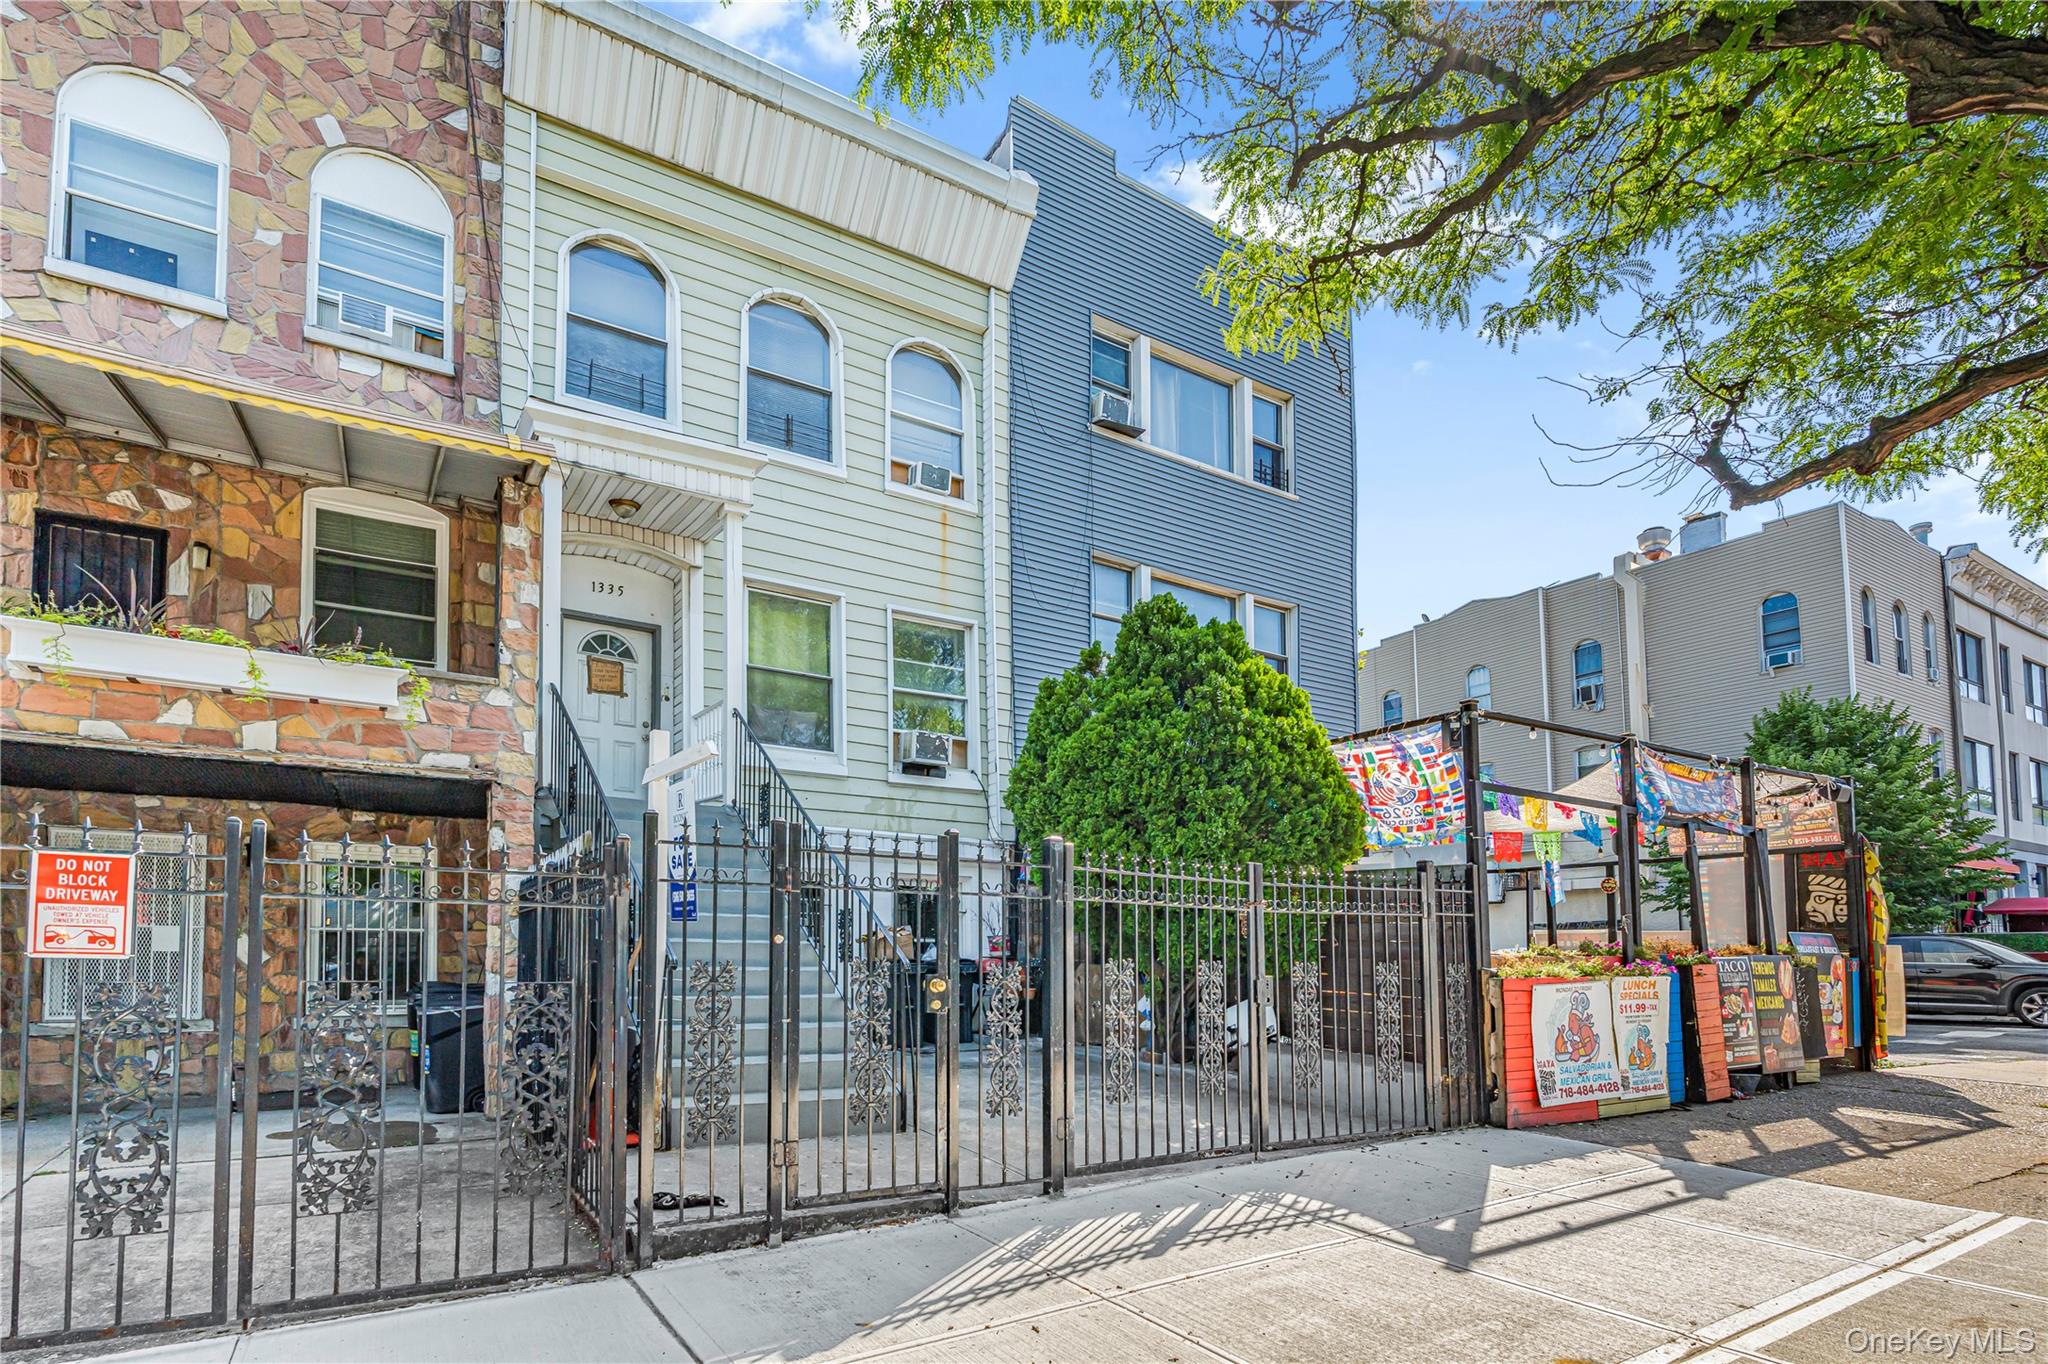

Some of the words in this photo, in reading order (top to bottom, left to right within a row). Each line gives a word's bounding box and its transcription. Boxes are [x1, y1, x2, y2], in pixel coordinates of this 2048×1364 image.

[592, 581, 624, 596] 1335
[674, 835, 691, 851] FO
[56, 858, 77, 871] DO
[83, 860, 112, 872] NOT
[672, 852, 692, 869] SAE
[58, 873, 107, 887] BLOCK
[45, 887, 118, 901] DRIVEWAY
[1716, 960, 1746, 972] TACO
[1751, 961, 1775, 975] TENEMOS
[1623, 980, 1656, 990] LUNCH
[1753, 979, 1776, 992] TAMALES
[1620, 991, 1659, 1000] SPECIALS
[1756, 995, 1784, 1009] MEXICANOS
[1620, 1003, 1646, 1014] $11.99
[1560, 1063, 1604, 1074] SALVADORIAN
[1607, 1061, 1612, 1069] &
[1560, 1074, 1589, 1086] MEXICAN
[1592, 1073, 1612, 1082] GRILL
[1559, 1082, 1620, 1099] 718-484-4128
